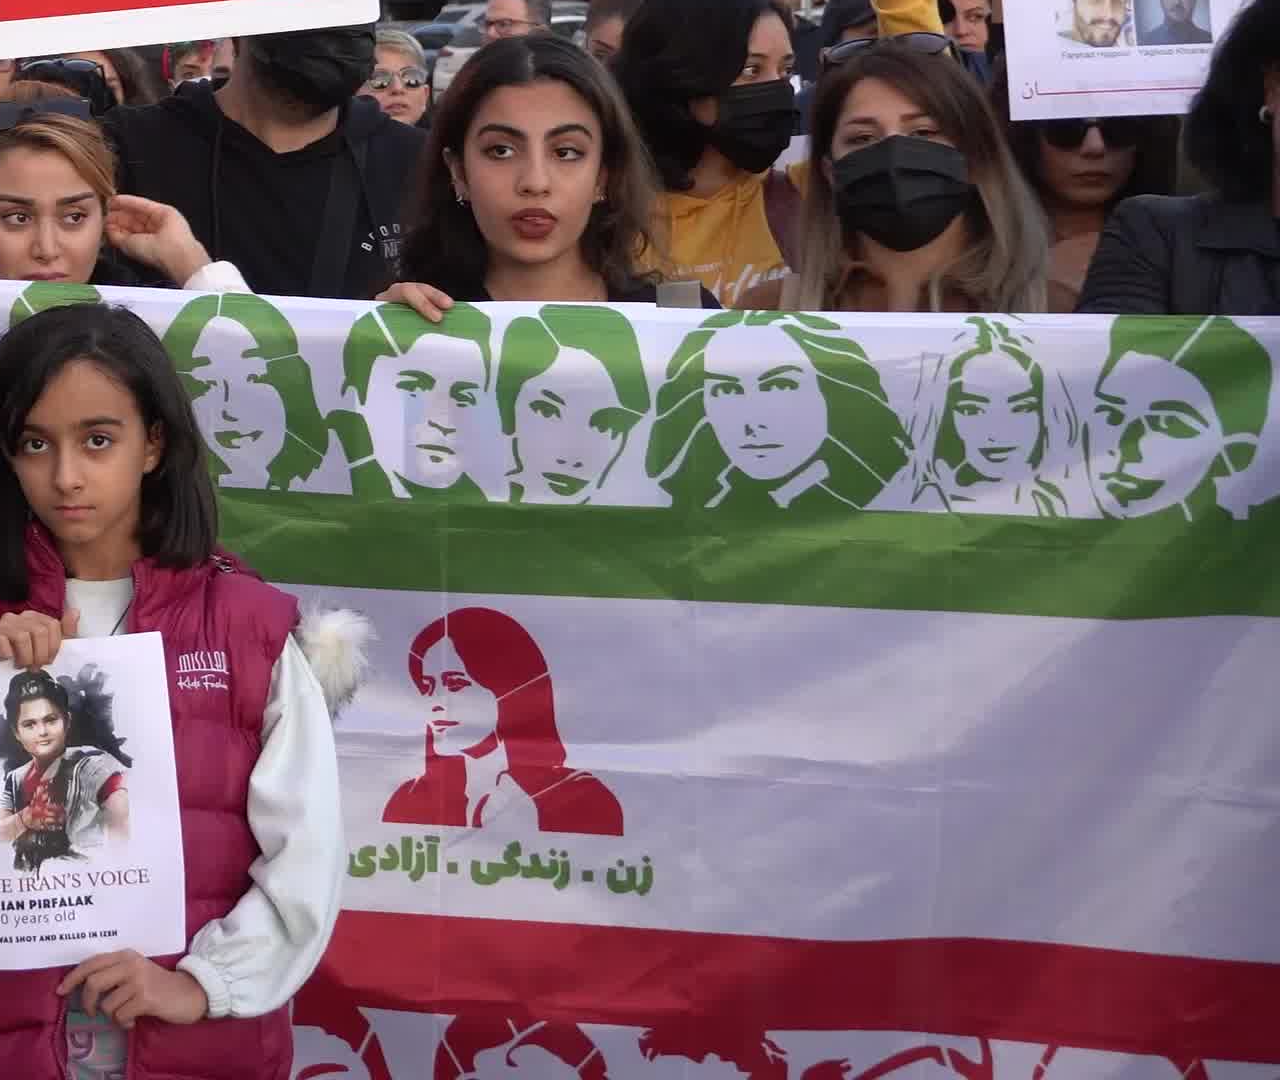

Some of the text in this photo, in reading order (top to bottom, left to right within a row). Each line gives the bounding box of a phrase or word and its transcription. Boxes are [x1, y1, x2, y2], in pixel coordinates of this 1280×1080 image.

[347, 834, 654, 896] زن زندگی آزادی
[18, 872, 82, 893] IRAN'S
[87, 868, 151, 888] VOICE
[29, 895, 94, 910] PIRFALAK
[14, 912, 49, 928] years
[54, 909, 76, 922] old
[15, 934, 37, 943] SHOT
[39, 933, 57, 942] AND
[58, 931, 87, 941] KILLED
[88, 930, 98, 938] IN
